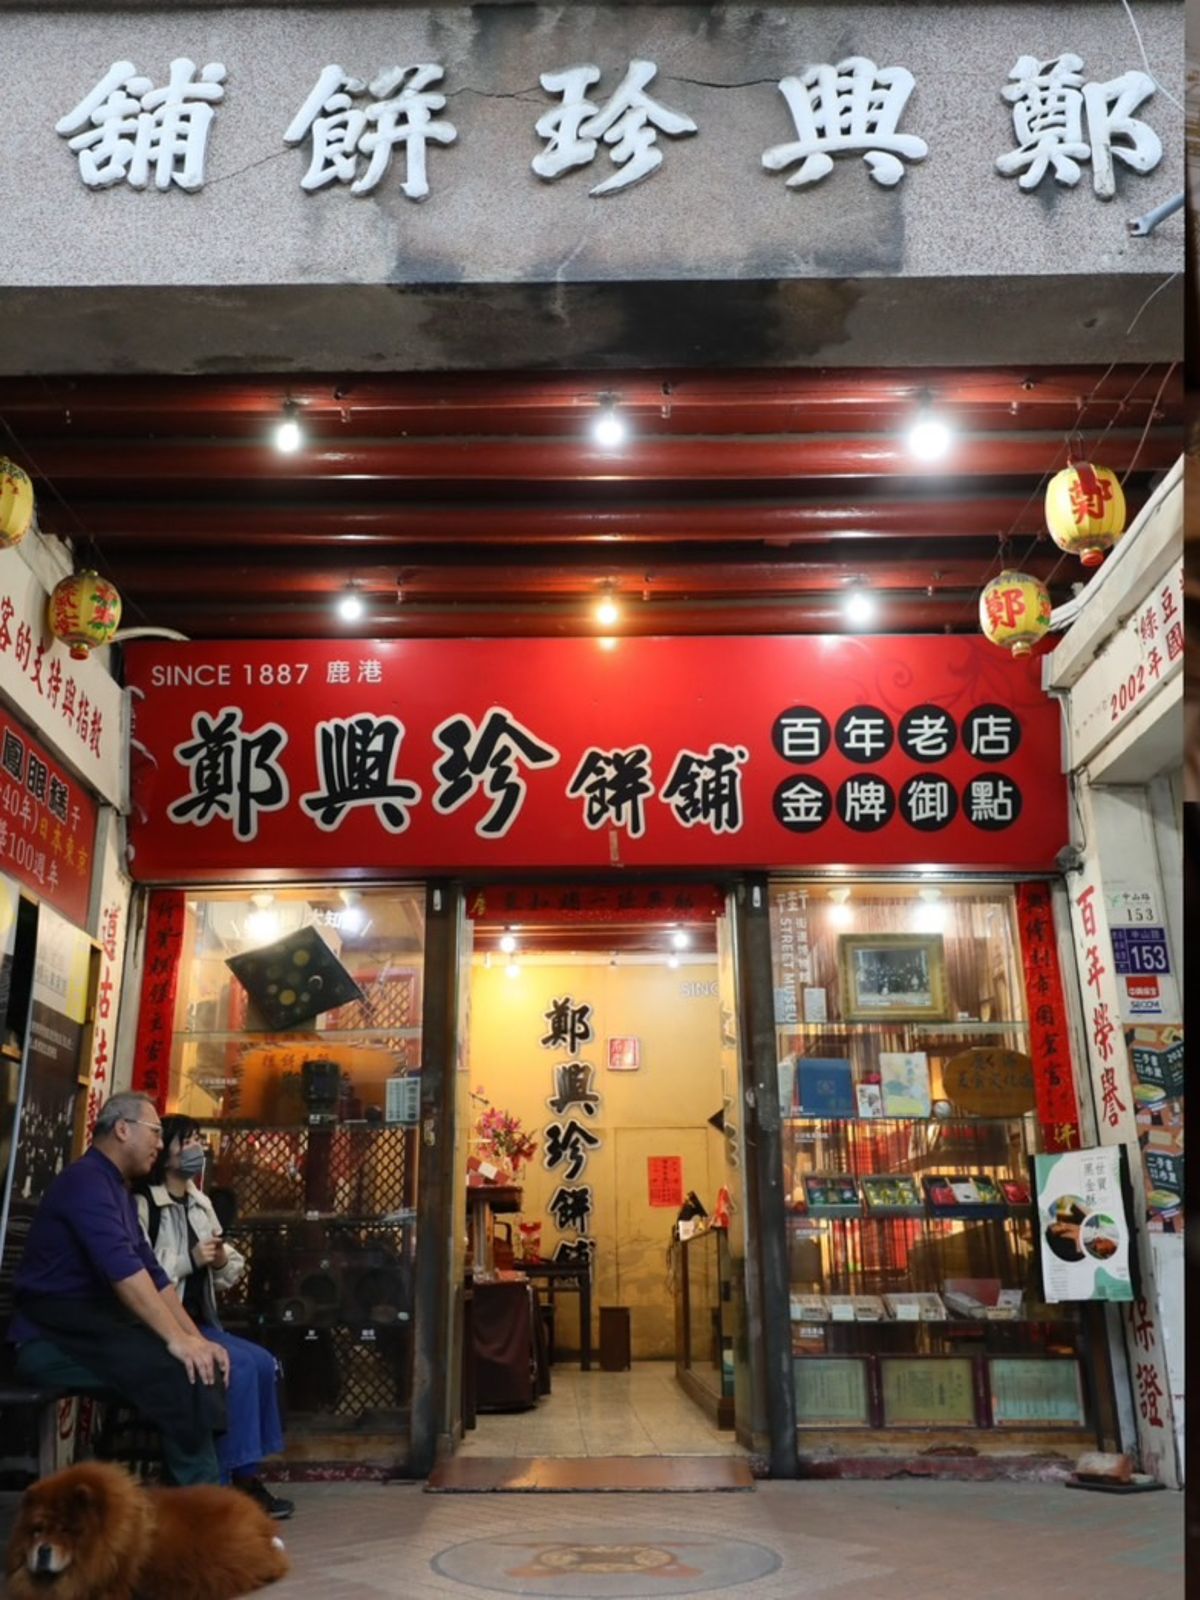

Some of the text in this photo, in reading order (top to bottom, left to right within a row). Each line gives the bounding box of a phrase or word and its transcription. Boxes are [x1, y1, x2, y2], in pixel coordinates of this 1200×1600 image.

[985, 588, 1025, 635] 鄭
[1140, 568, 1184, 641] 綠豆
[151, 659, 382, 687] SINCE 1887 鹿港
[780, 715, 1013, 757] 百年老店
[780, 780, 1013, 824] 金牌御點
[1127, 908, 1154, 922] 153
[780, 918, 794, 970] STREET
[1131, 946, 1167, 970] 153
[1075, 885, 1128, 1128] 百年榮譽
